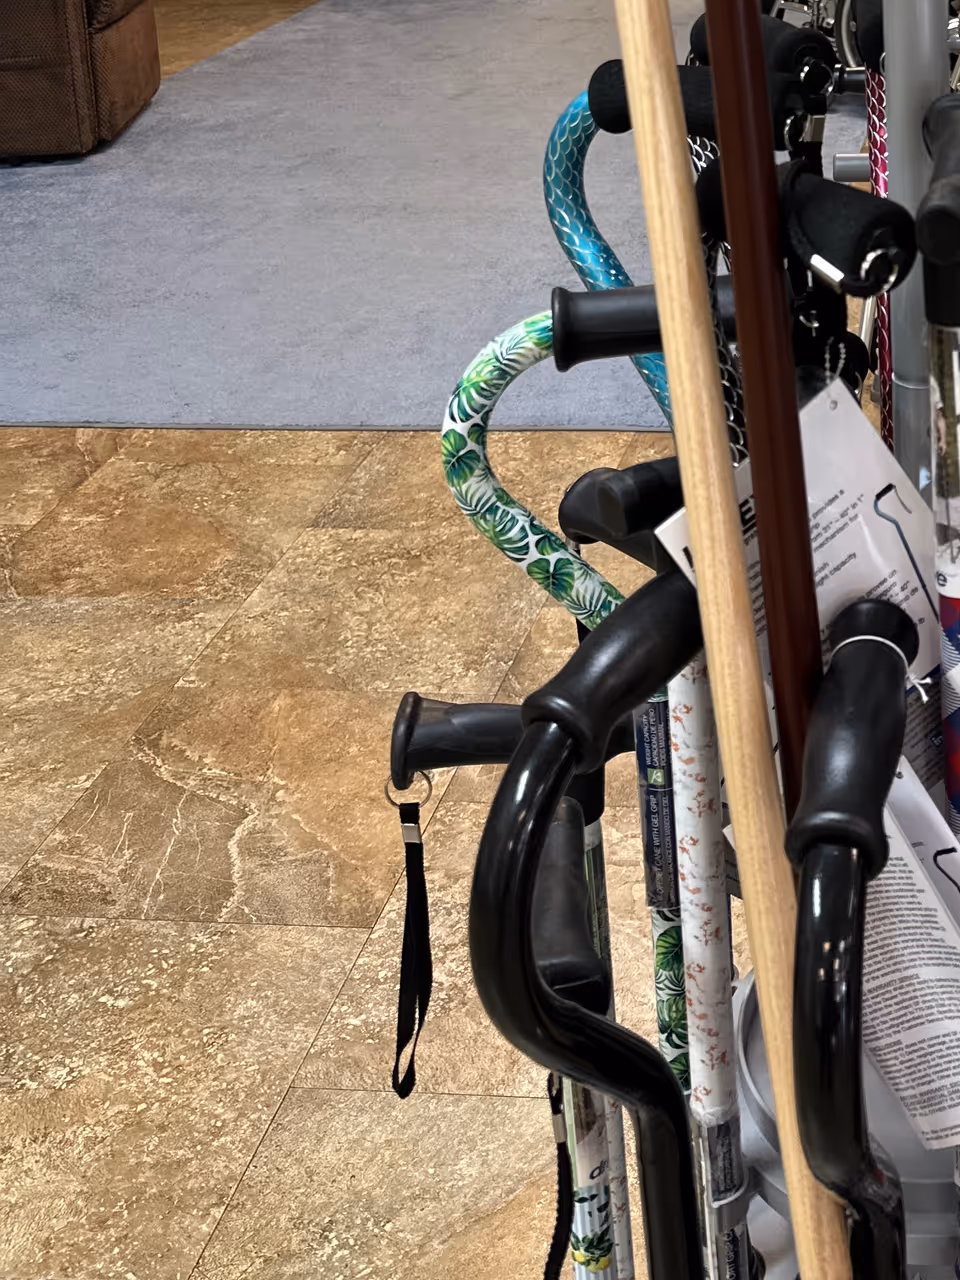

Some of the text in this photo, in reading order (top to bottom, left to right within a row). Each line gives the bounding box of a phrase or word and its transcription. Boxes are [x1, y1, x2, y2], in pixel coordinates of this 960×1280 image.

[650, 724, 656, 732] DE
[642, 714, 652, 765] WEIGHT CAPACITY
[650, 732, 659, 766] CAPACIDAD
[649, 794, 658, 812] GRIP
[650, 813, 659, 827] GEL
[651, 828, 660, 846] WITH
[653, 846, 662, 867] CANE
